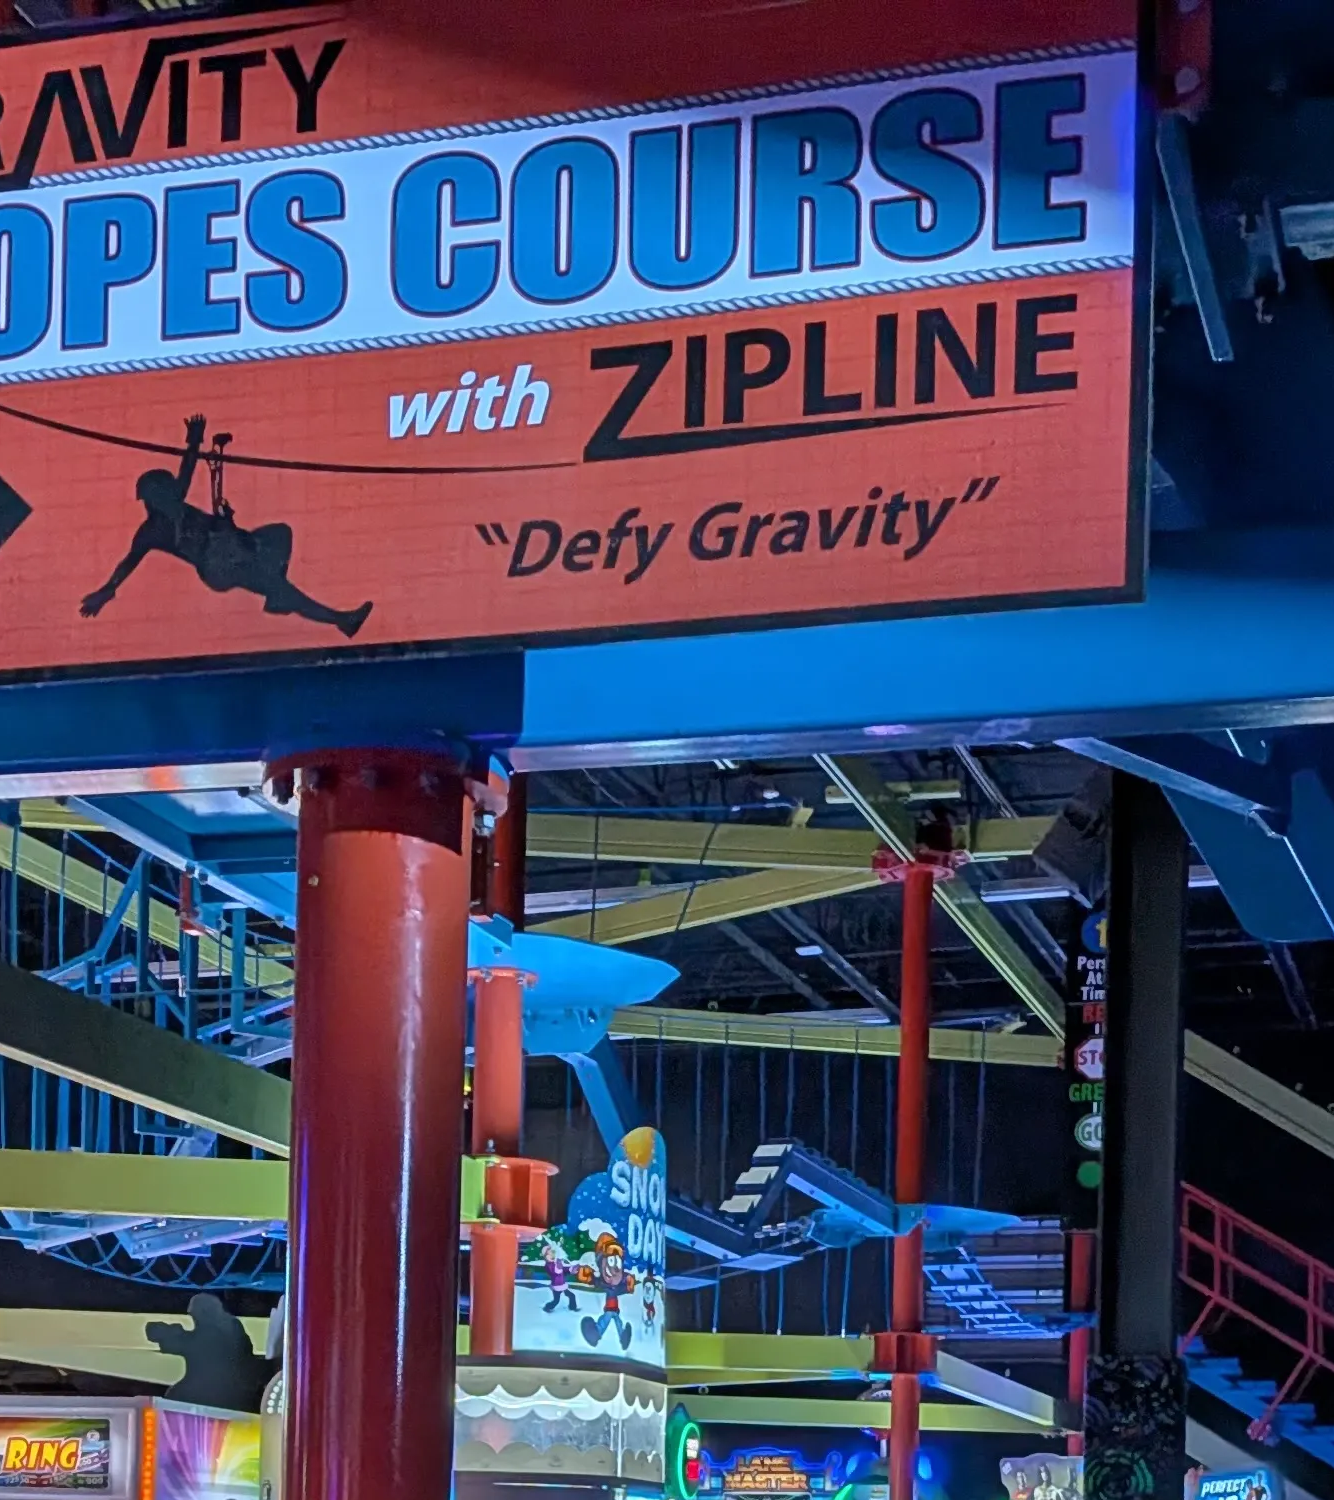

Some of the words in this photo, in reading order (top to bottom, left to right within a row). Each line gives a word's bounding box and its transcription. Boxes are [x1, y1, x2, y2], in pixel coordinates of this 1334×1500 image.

[390, 70, 1091, 320] COURSE
[386, 366, 551, 444] with
[581, 294, 1081, 464] ZIPLINE
[2, 1435, 82, 1475] RING
[738, 1456, 791, 1472] LANE
[1201, 1478, 1245, 1498] PERFECT
